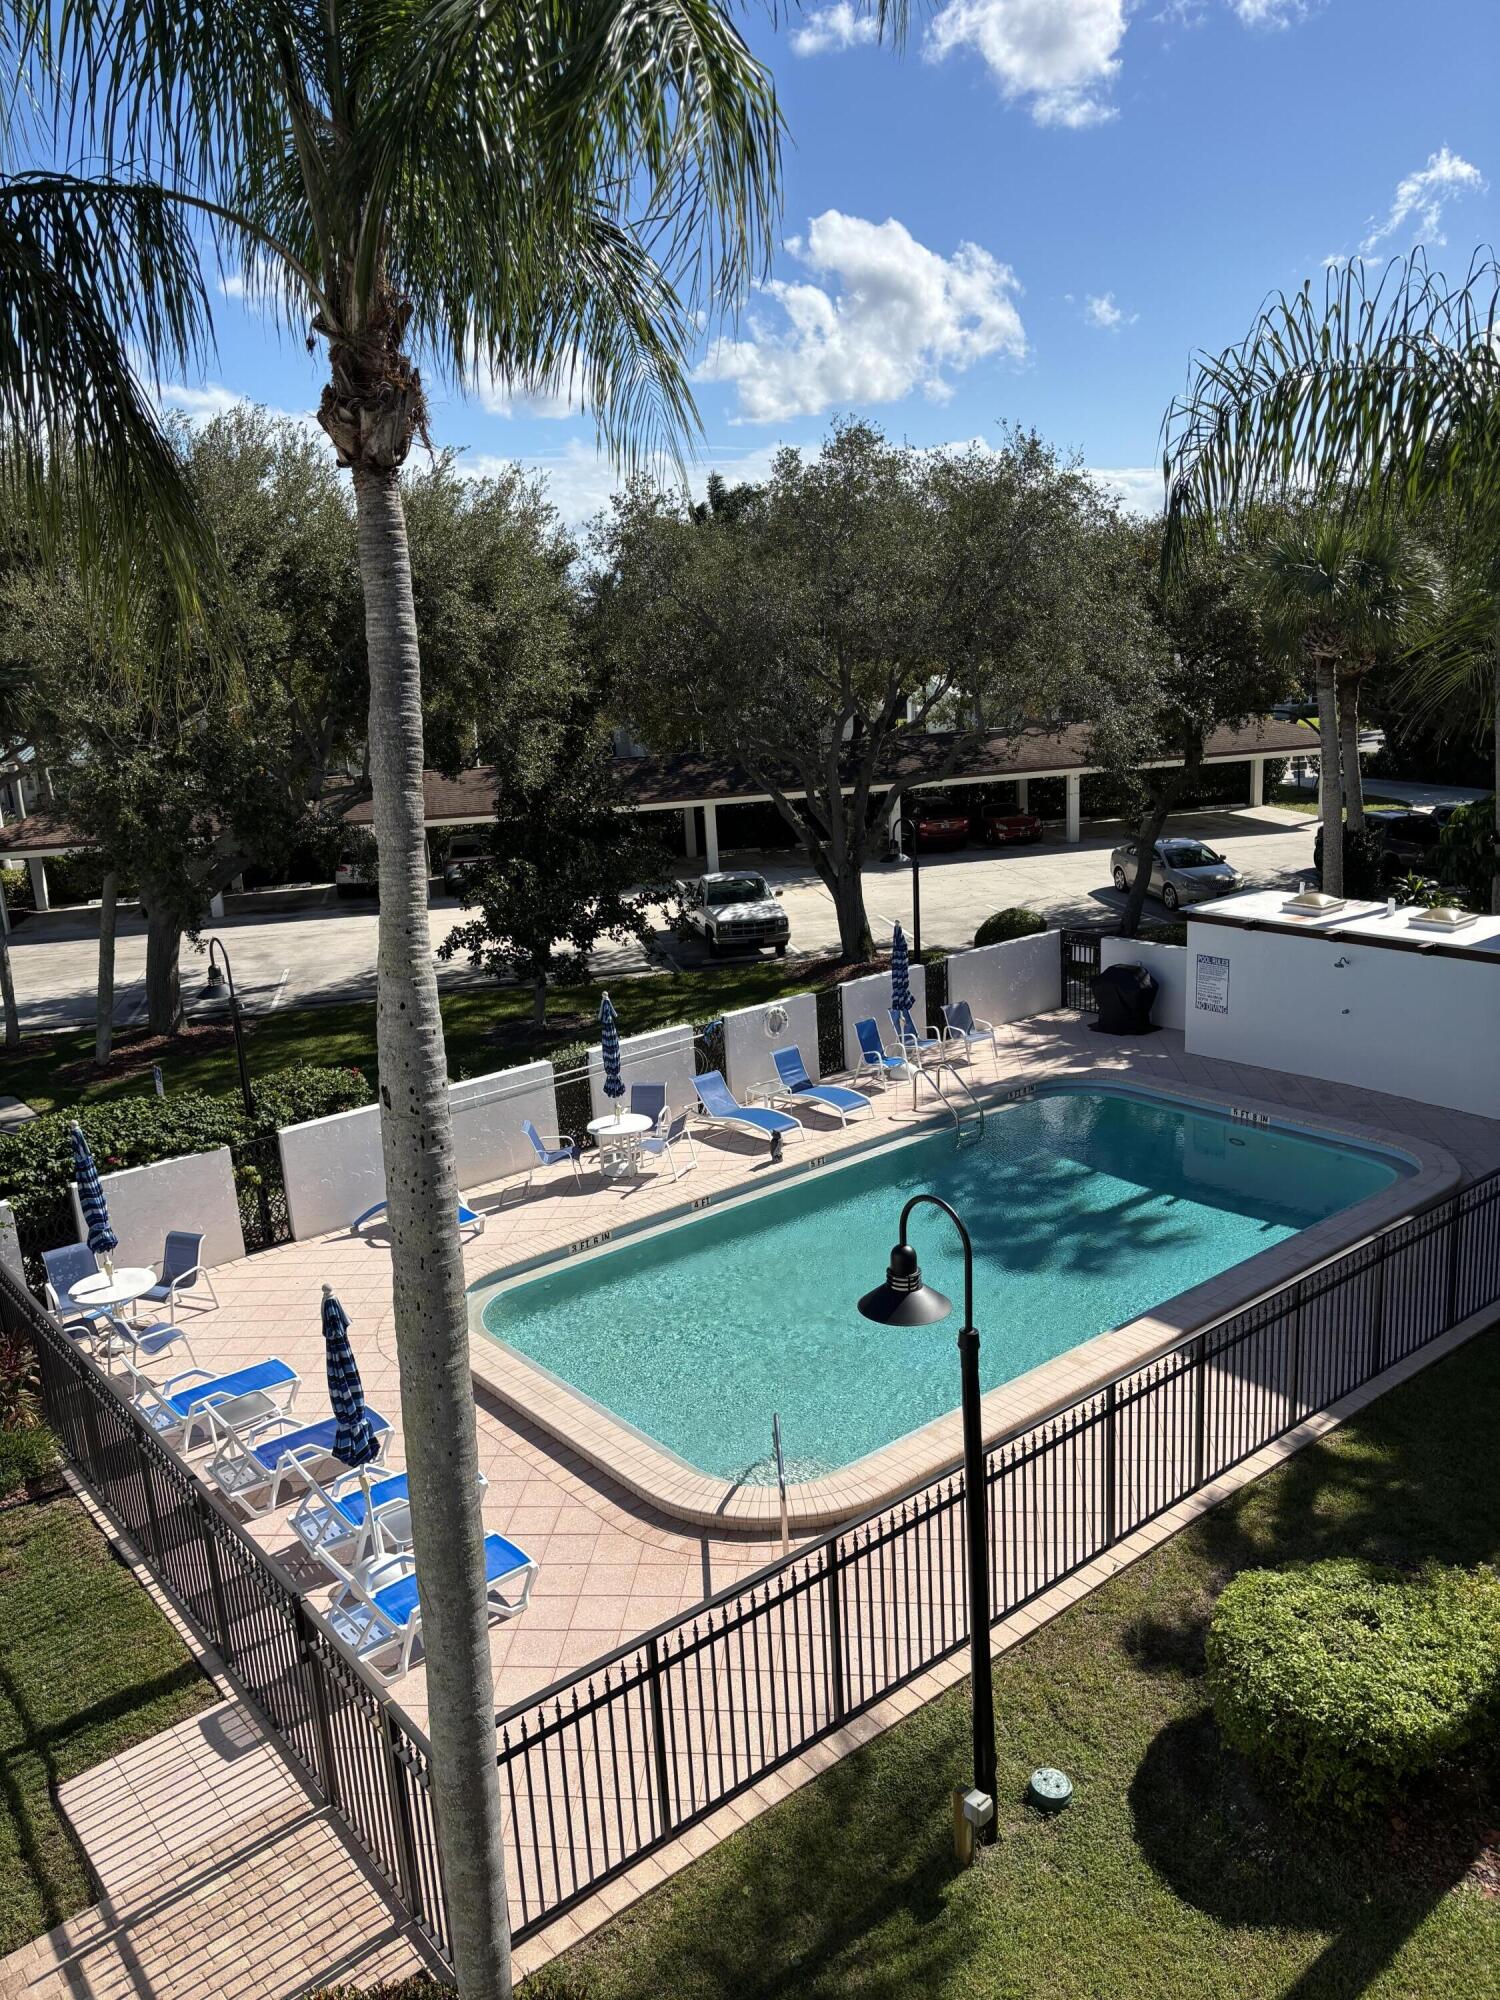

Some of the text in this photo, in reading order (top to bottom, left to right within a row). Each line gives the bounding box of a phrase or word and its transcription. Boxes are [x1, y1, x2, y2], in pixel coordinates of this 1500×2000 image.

[1206, 1003, 1228, 1014] DIVING
[1241, 1110, 1249, 1119] FT
[1260, 1114, 1268, 1123] IN
[701, 1196, 710, 1207] FT
[571, 1244, 578, 1253] 3
[580, 1239, 590, 1251] FT
[601, 1230, 610, 1241] IN
